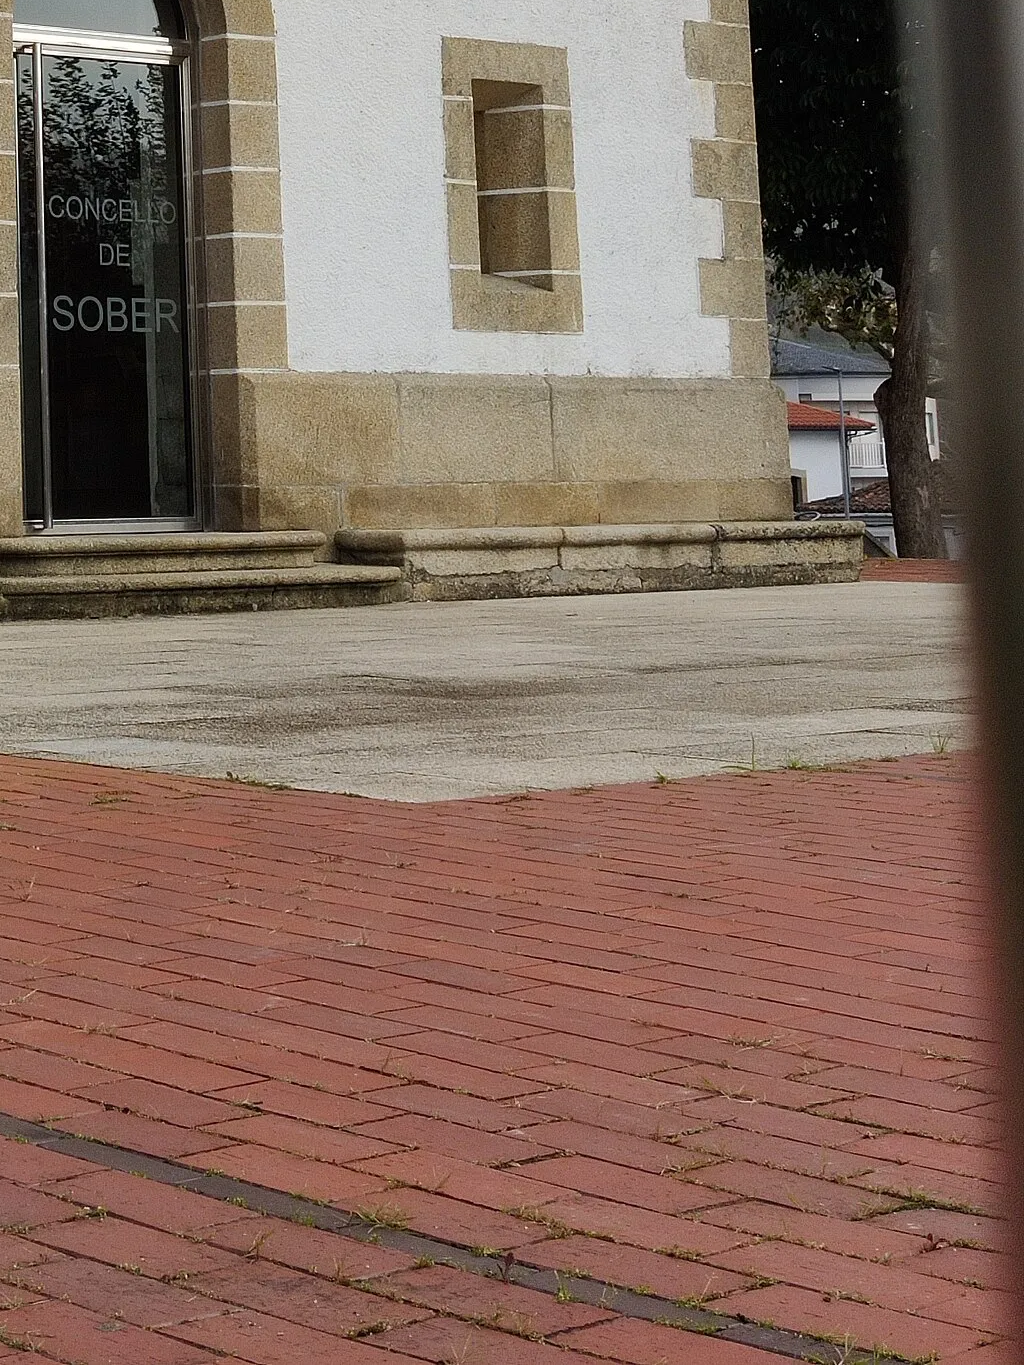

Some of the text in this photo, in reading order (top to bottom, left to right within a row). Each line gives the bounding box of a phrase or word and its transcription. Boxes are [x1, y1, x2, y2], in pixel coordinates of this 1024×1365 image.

[48, 194, 176, 224] CONCELLO
[99, 243, 130, 267] DE
[52, 295, 179, 333] SOBER
